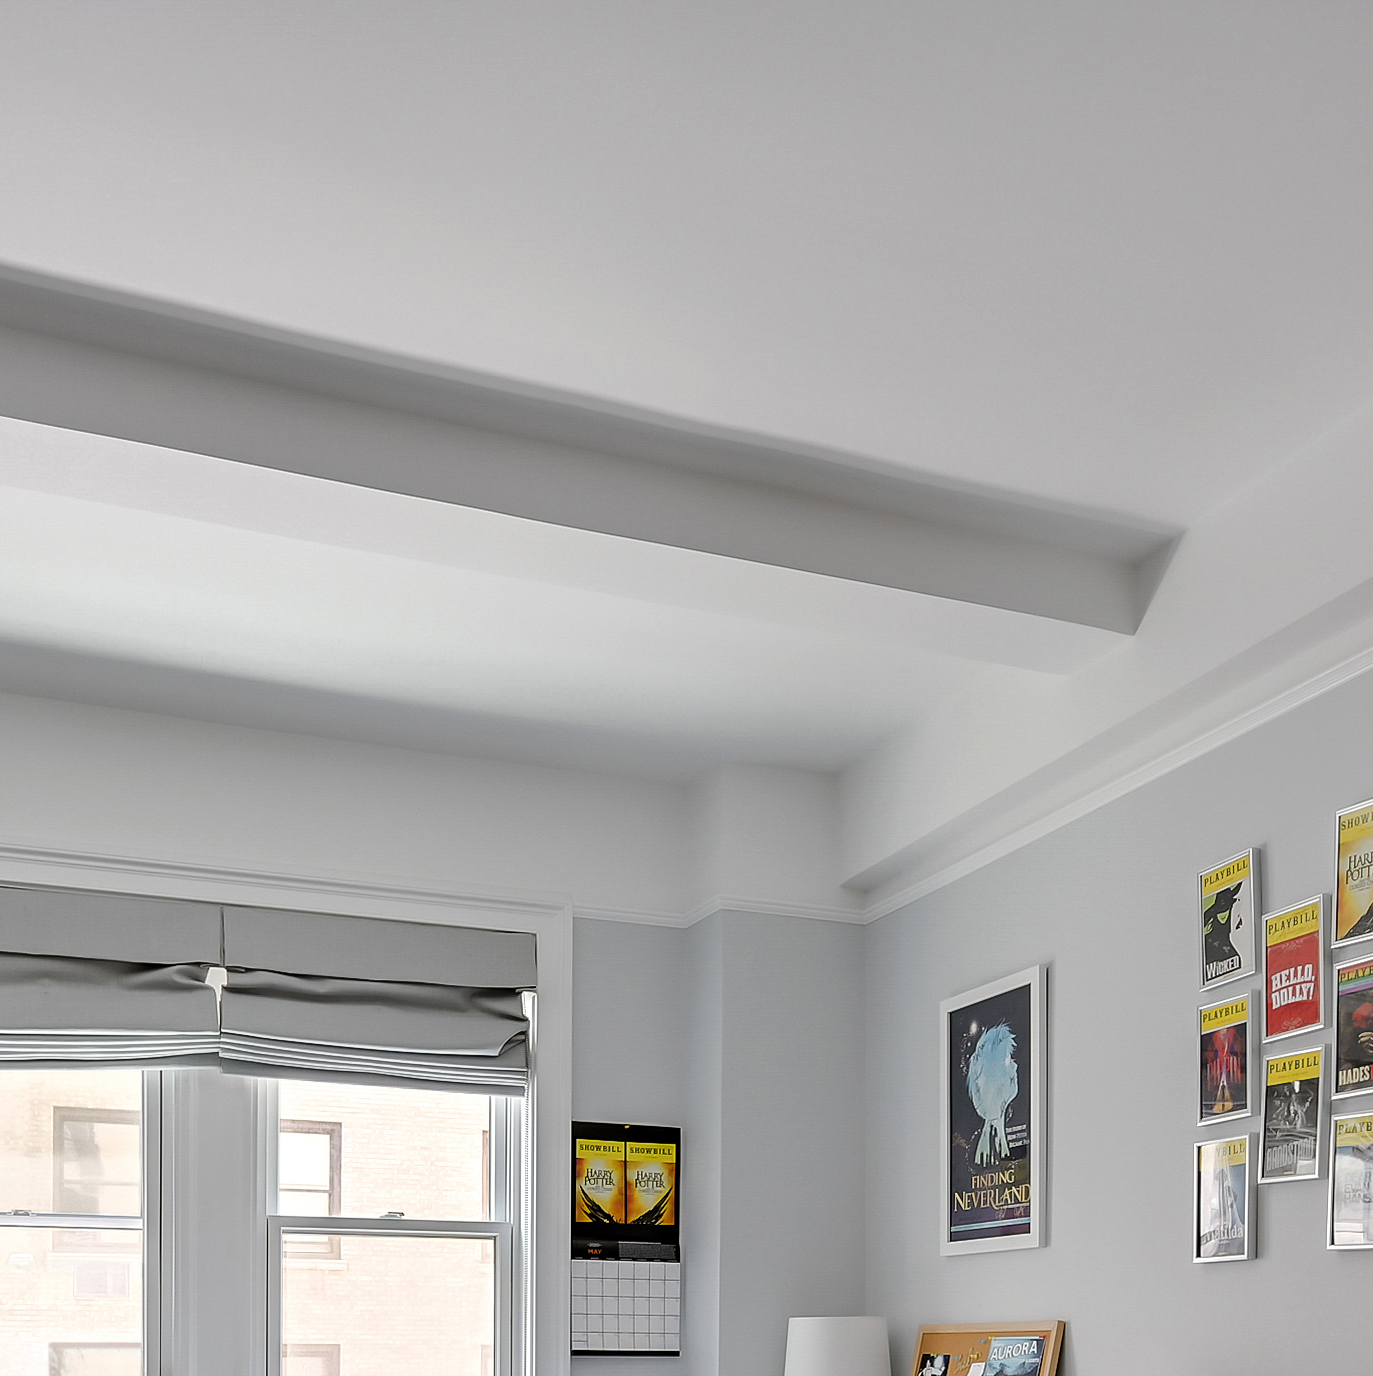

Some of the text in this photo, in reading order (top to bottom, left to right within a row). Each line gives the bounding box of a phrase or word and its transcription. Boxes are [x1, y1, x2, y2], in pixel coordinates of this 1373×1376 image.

[1204, 859, 1249, 888] PLAYBILL
[1268, 909, 1318, 936] PLAYBILL
[1271, 963, 1316, 992] HELLO,
[1271, 982, 1316, 1010] DOLLY!
[1202, 1002, 1247, 1024] PLAYBILL
[1269, 1056, 1319, 1075] PLAYBILL
[579, 1144, 622, 1153] SHOWBILL
[629, 1147, 673, 1156] SHOWBILL
[1265, 1136, 1316, 1172] BANDSTAND
[584, 1176, 616, 1187] POTTER
[586, 1168, 615, 1181] HARRY
[634, 1178, 666, 1189] POTTER
[636, 1170, 665, 1183] HARRY
[971, 1169, 1015, 1189] FINDING
[953, 1183, 1033, 1212] NEVERLAND
[989, 1340, 1039, 1362] AURORA
